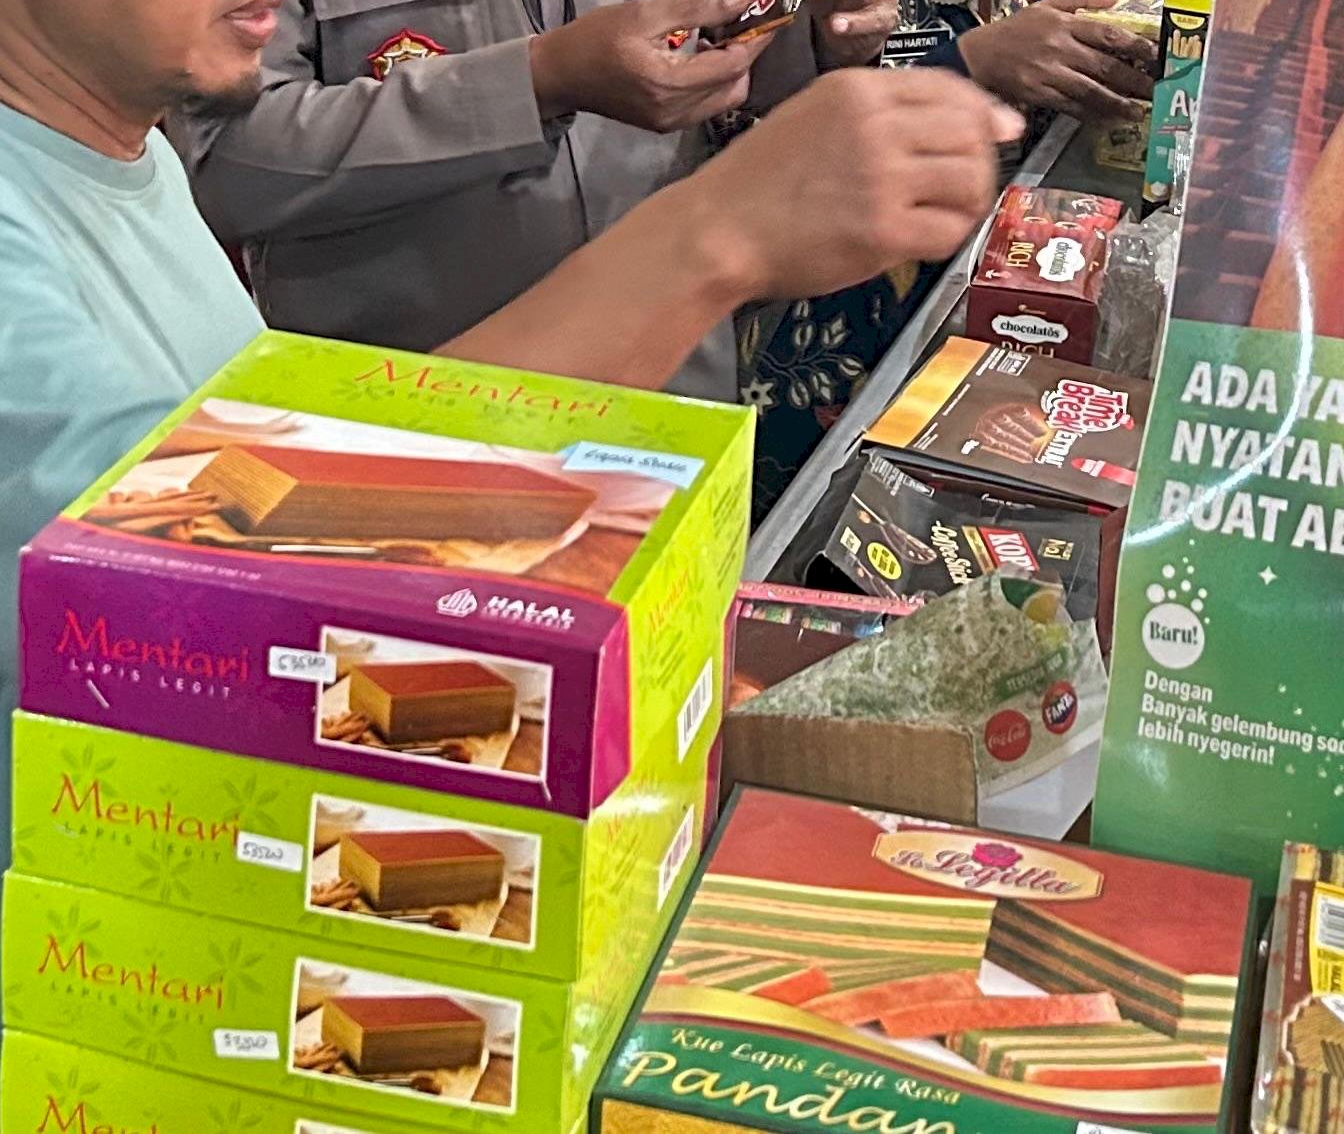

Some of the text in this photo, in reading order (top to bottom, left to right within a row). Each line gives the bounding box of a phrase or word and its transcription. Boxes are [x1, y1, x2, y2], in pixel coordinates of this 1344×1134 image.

[905, 35, 939, 49] HARTATI
[1006, 242, 1035, 268] RICH
[357, 357, 618, 420] Mentari
[1054, 381, 1095, 434] Break
[1082, 393, 1124, 430] Time
[1181, 361, 1279, 415] ADA
[1158, 480, 1289, 543] BUAT
[486, 596, 576, 625] HALAL
[1149, 624, 1199, 646] Baru!
[58, 610, 251, 682] Mentari
[68, 657, 233, 699] LAPIS LEGIT
[1143, 670, 1214, 705] Dengan
[1137, 718, 1276, 768] lebih nyegerin!
[1141, 693, 1208, 728] Banyak
[1210, 710, 1314, 754] gelembung
[49, 772, 242, 846] Mentari
[38, 933, 226, 1010] Mentari
[620, 1049, 958, 1134] Pandan
[668, 1026, 962, 1106] Kue Lapis Legit Rasa
